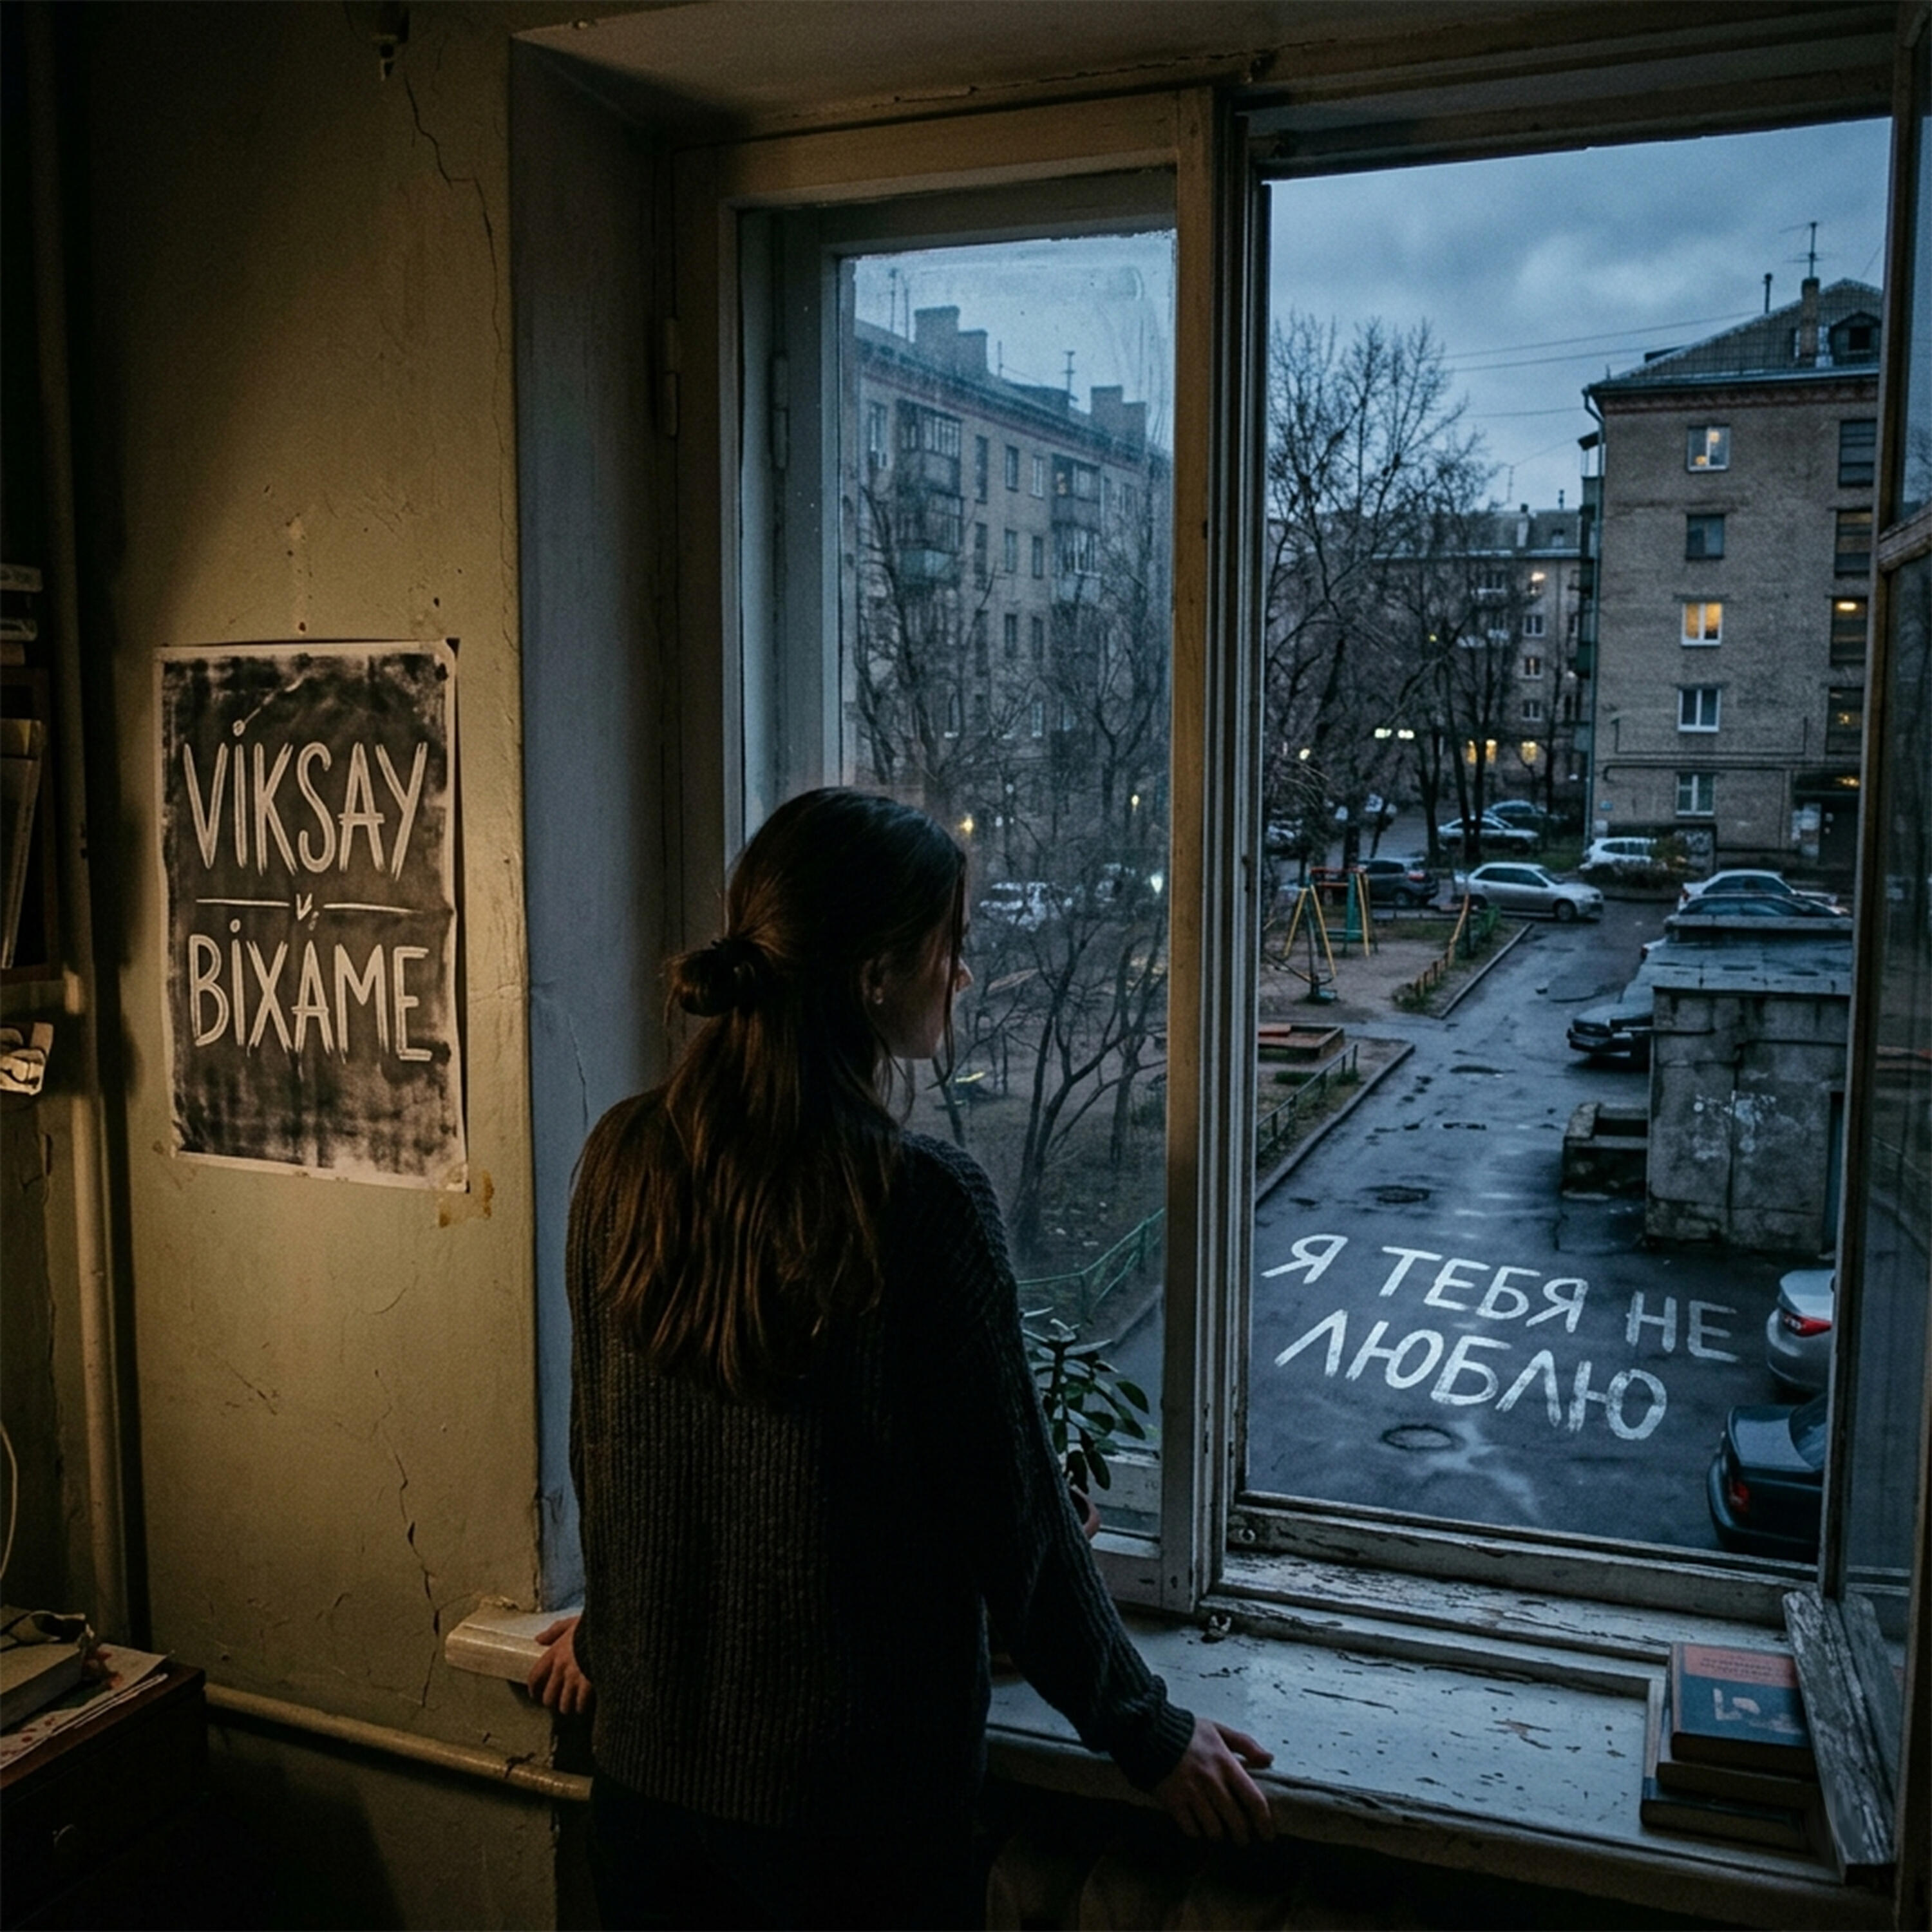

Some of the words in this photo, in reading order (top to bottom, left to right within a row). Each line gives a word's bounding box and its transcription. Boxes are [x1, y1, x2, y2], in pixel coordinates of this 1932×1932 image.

[1261, 1233, 1349, 1284] Я
[1382, 1246, 1589, 1333] ТЕБЯ
[1626, 1291, 1741, 1363] НЕ
[1274, 1309, 1668, 1441] ЛЮБЛЮ
